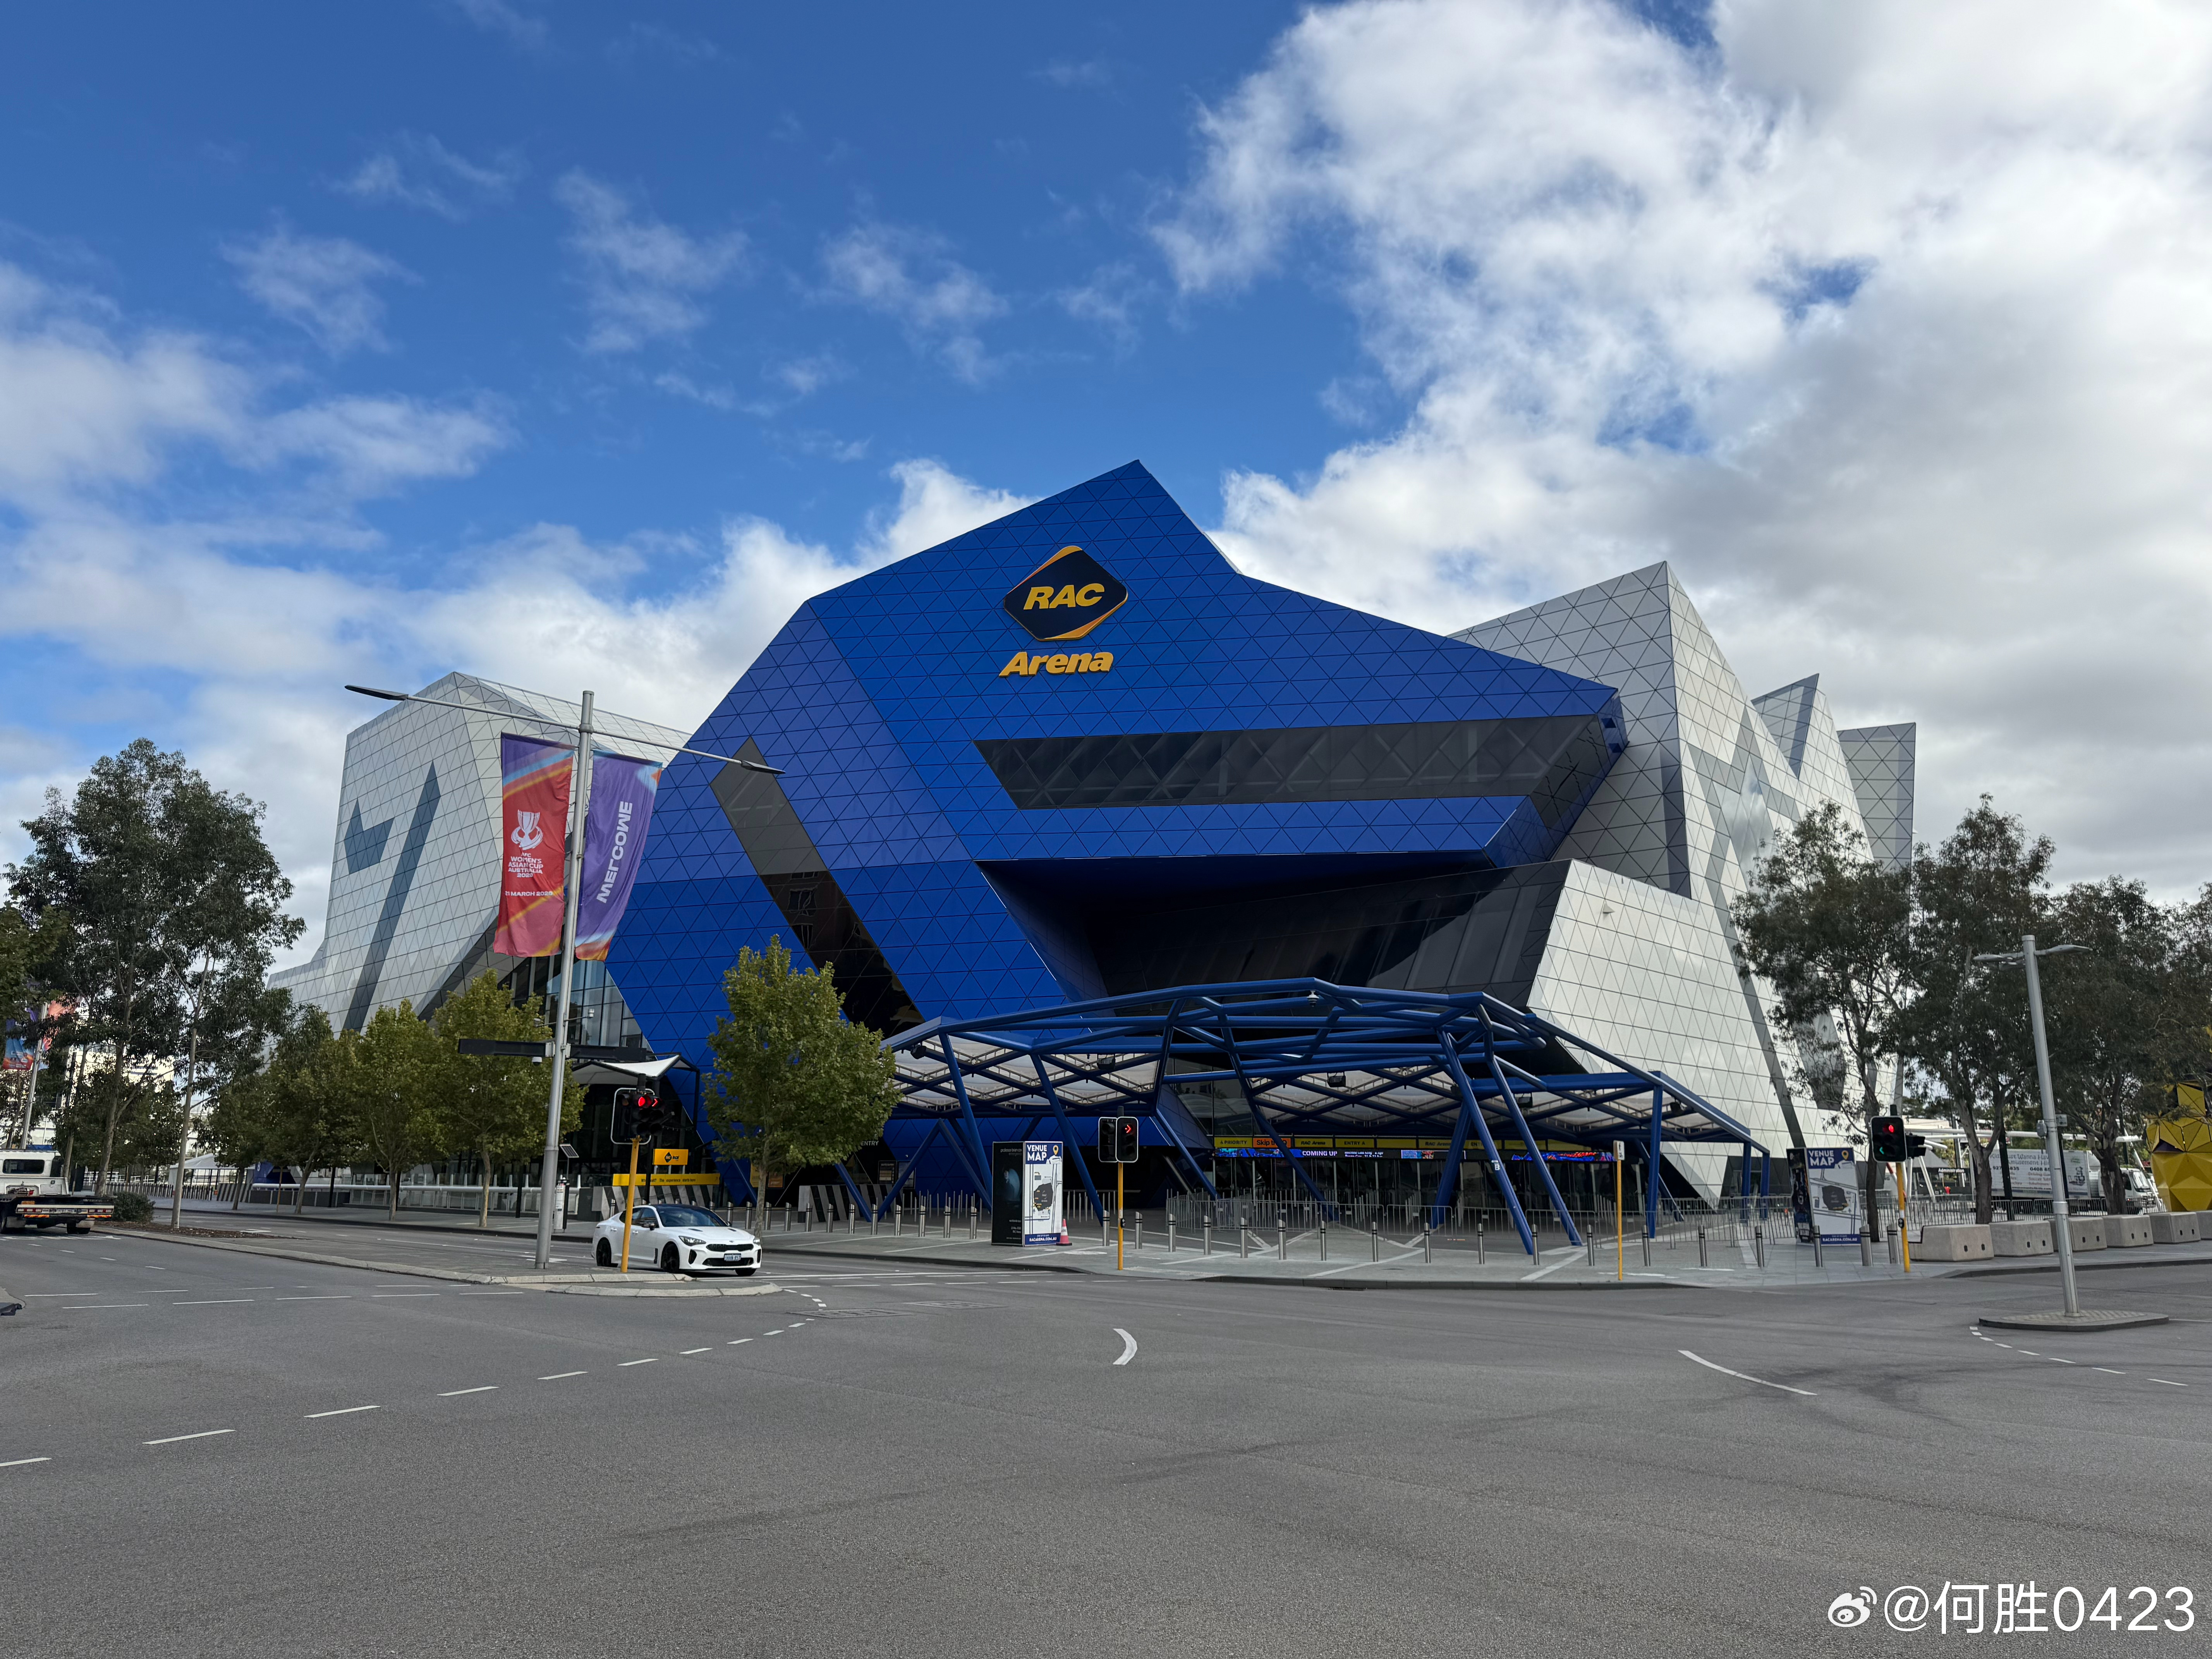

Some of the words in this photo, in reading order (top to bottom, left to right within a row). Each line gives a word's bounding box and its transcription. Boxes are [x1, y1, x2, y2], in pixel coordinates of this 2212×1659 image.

[1023, 583, 1105, 610] RAC
[999, 651, 1114, 678] Arena
[1027, 1152, 1047, 1161] MAP
[1810, 1157, 1834, 1166] MAP
